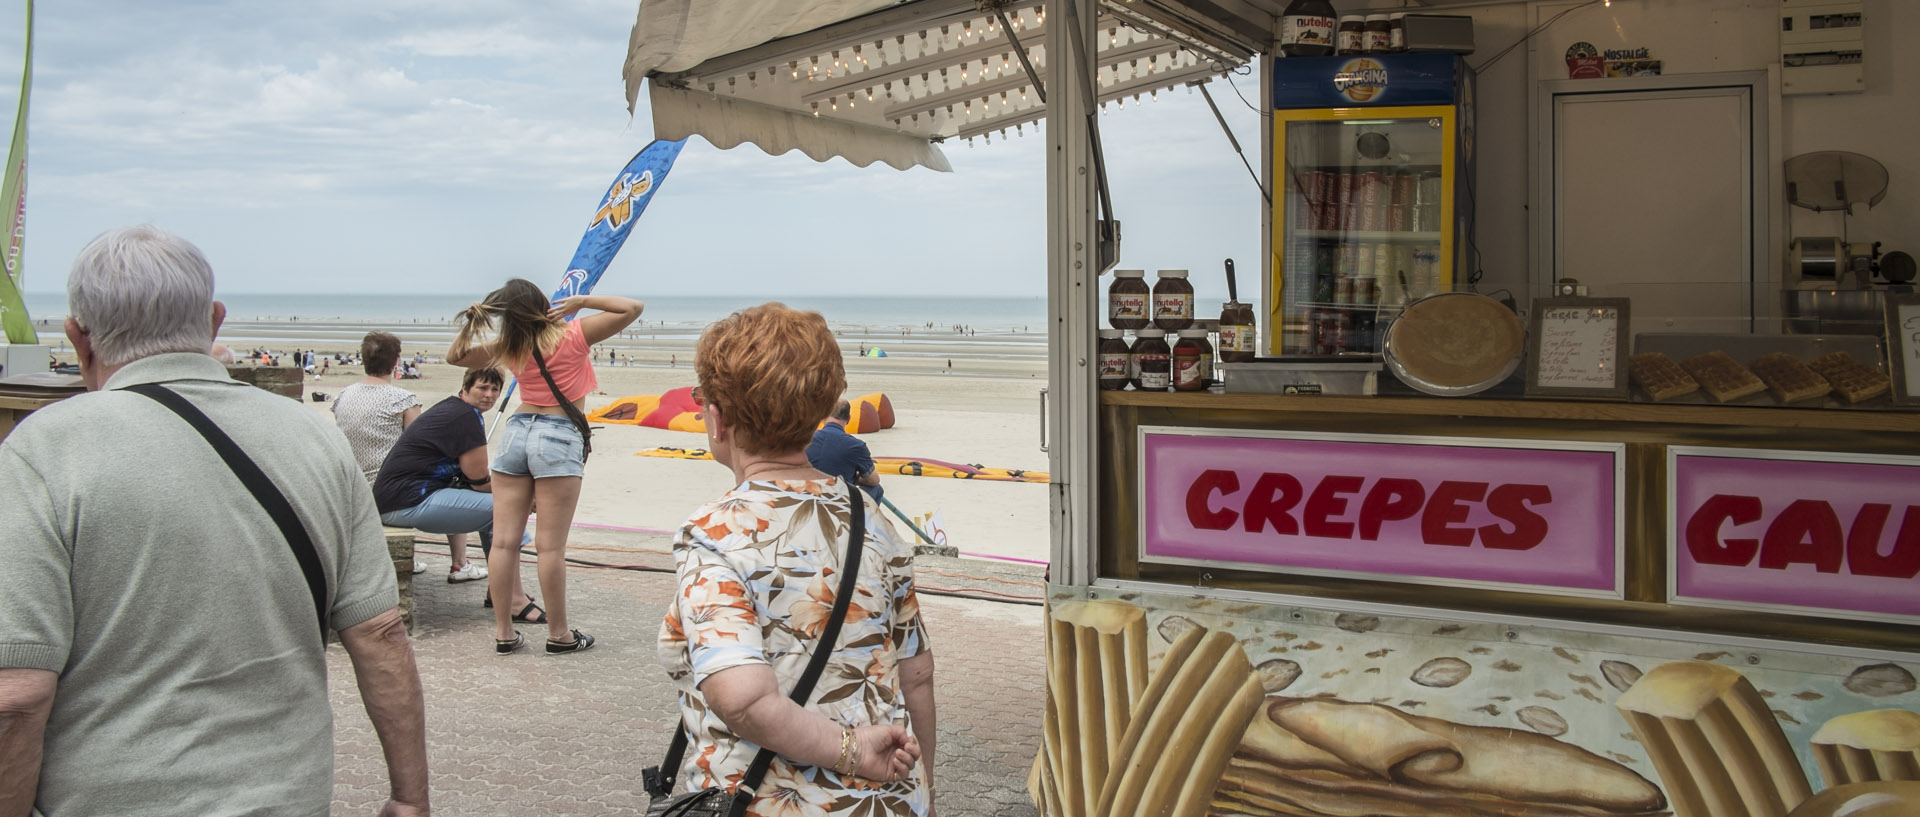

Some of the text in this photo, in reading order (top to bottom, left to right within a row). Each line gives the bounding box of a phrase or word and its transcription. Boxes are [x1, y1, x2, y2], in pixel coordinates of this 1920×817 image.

[1296, 16, 1333, 28] nutella
[1334, 68, 1389, 93] ORANGINA
[1116, 299, 1143, 307] nutella
[1157, 298, 1184, 307] nutella
[1100, 358, 1127, 367] nutella
[1185, 469, 1552, 551] CREPES
[1685, 494, 1920, 580] GAU
